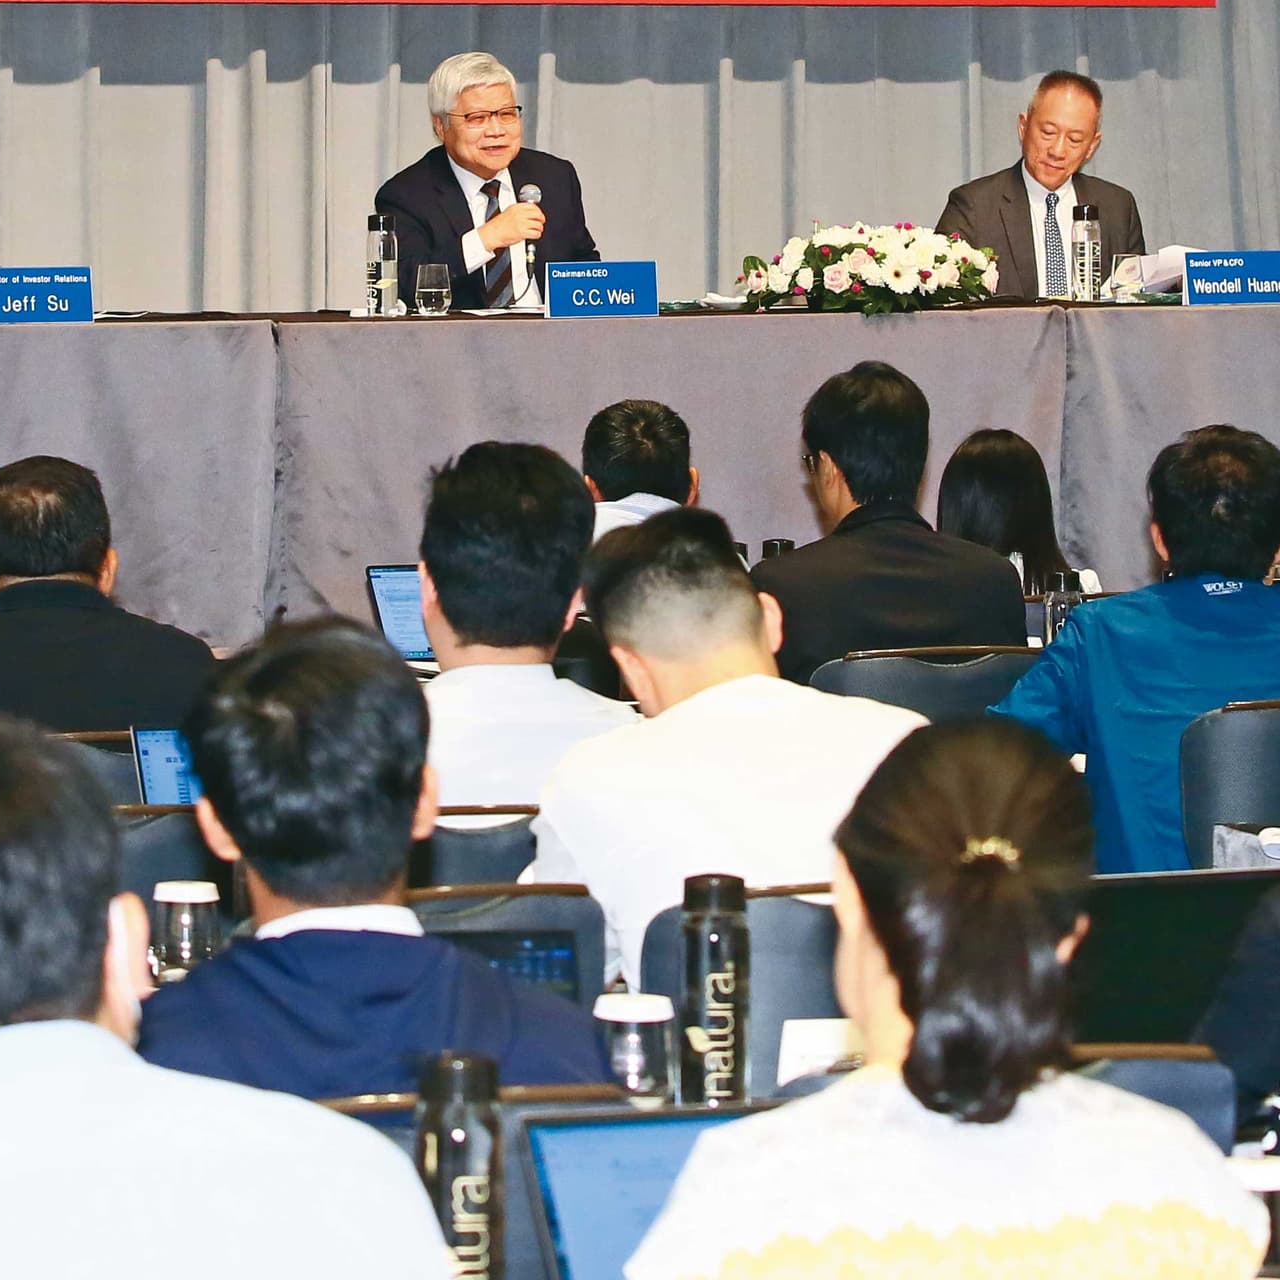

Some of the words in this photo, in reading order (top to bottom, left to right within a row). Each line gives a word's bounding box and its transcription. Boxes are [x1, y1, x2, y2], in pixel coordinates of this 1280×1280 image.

[11, 275, 20, 284] of
[22, 274, 50, 283] Investor
[54, 273, 87, 283] Relations
[1192, 277, 1241, 293] Wendell
[1, 294, 35, 312] Jeff
[47, 293, 68, 311] Su
[571, 288, 603, 305] C.C.
[606, 287, 634, 304] Wei
